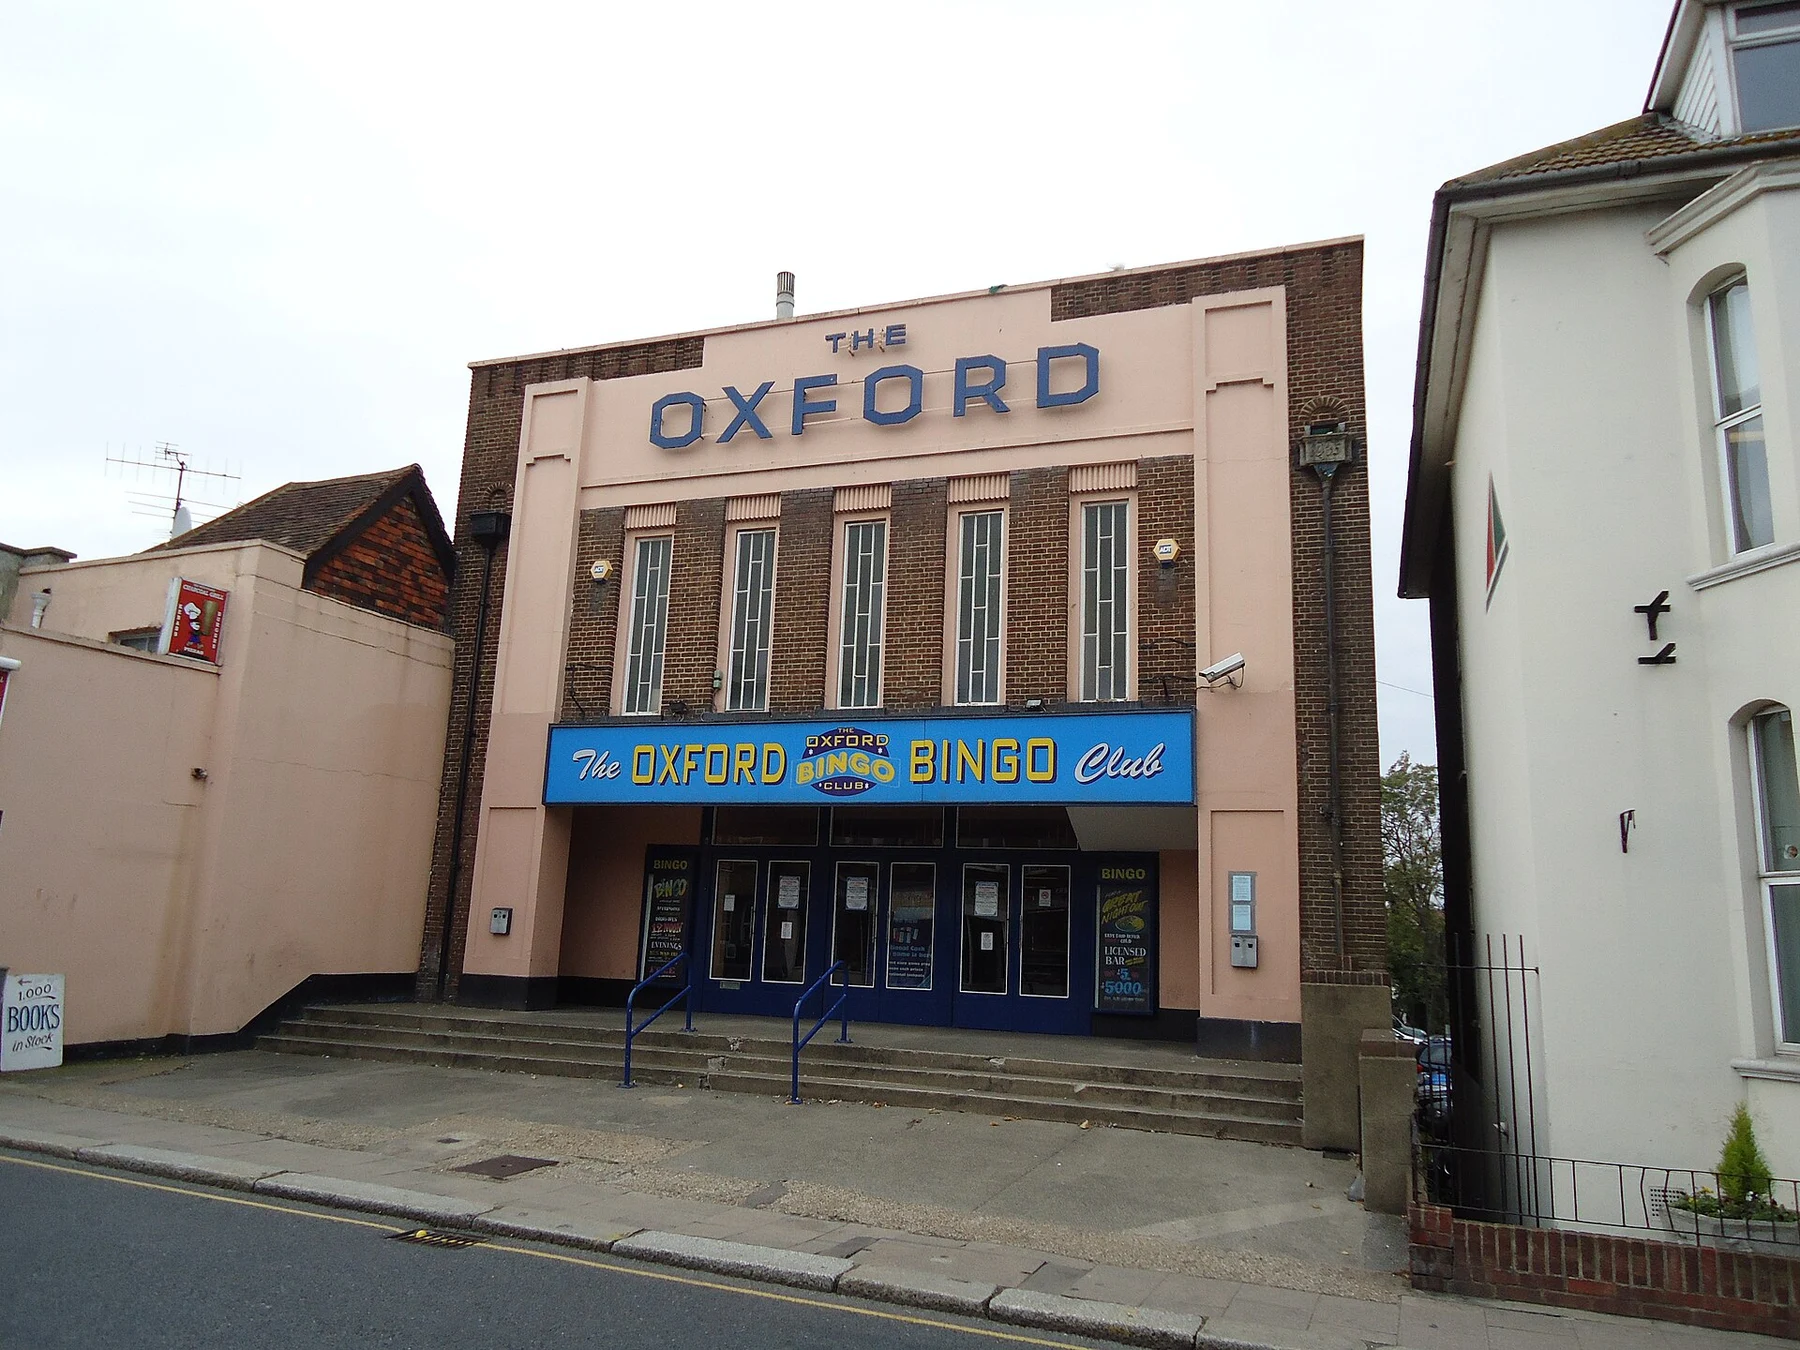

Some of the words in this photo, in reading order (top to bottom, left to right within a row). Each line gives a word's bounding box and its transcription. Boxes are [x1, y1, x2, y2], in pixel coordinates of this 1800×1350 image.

[825, 323, 907, 354] THE
[649, 342, 1100, 450] OXFORD
[805, 734, 889, 748] OXFORD
[572, 748, 621, 781] The
[631, 742, 788, 786] OXFORD
[795, 751, 896, 785] BINGO
[909, 737, 1058, 785] BINGO
[1074, 742, 1166, 785] Club
[823, 781, 864, 791] CLUB
[653, 859, 688, 870] BINGO
[1101, 868, 1146, 880] BINGO
[651, 941, 682, 950] EVENINGS
[1104, 946, 1147, 957] LICENSED
[1105, 956, 1125, 965] BAR
[8, 1003, 61, 1034] BOOKS
[12, 1040, 24, 1053] in
[25, 1032, 54, 1049] Stock
